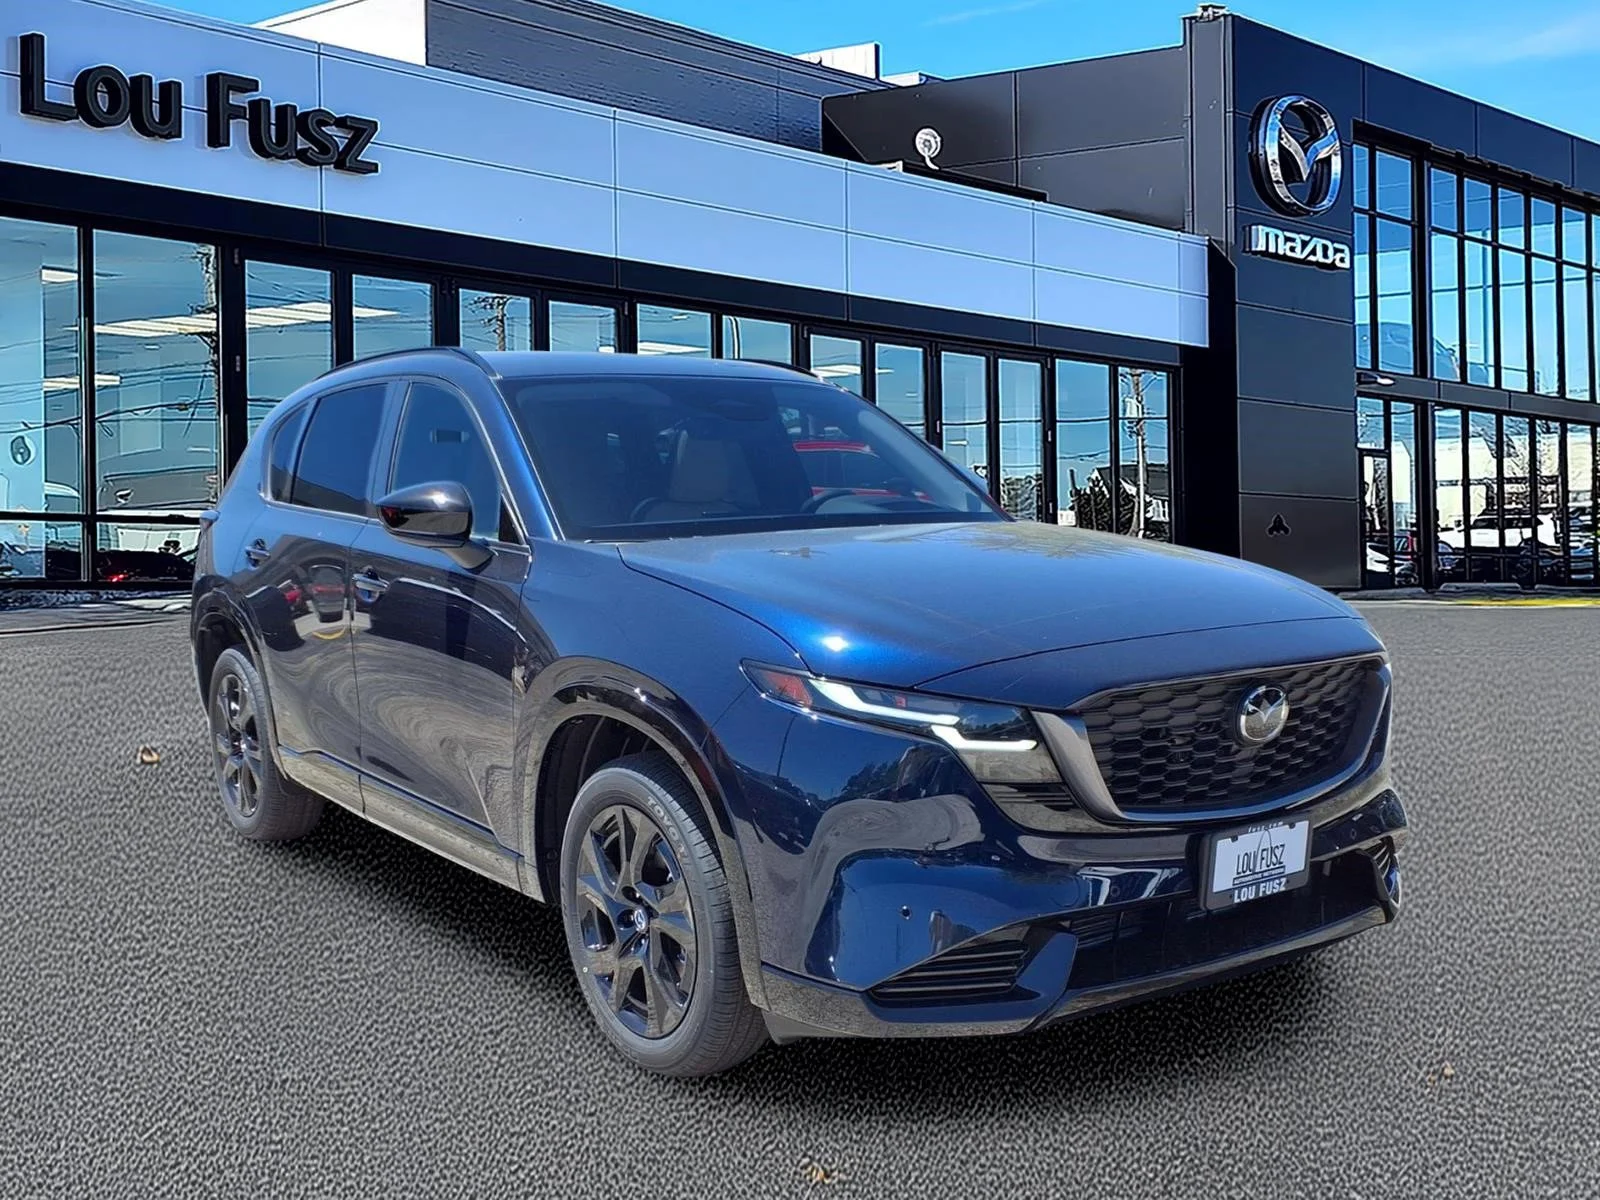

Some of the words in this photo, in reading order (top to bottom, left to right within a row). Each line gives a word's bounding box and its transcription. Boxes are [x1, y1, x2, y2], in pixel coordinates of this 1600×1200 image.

[19, 32, 182, 140] Lou
[206, 71, 379, 174] Fusz
[647, 796, 679, 840] TOYO
[1236, 850, 1257, 875] LOU
[1259, 844, 1285, 869] FUSZ
[1233, 885, 1255, 903] LOU
[1259, 877, 1287, 896] FUSZ
